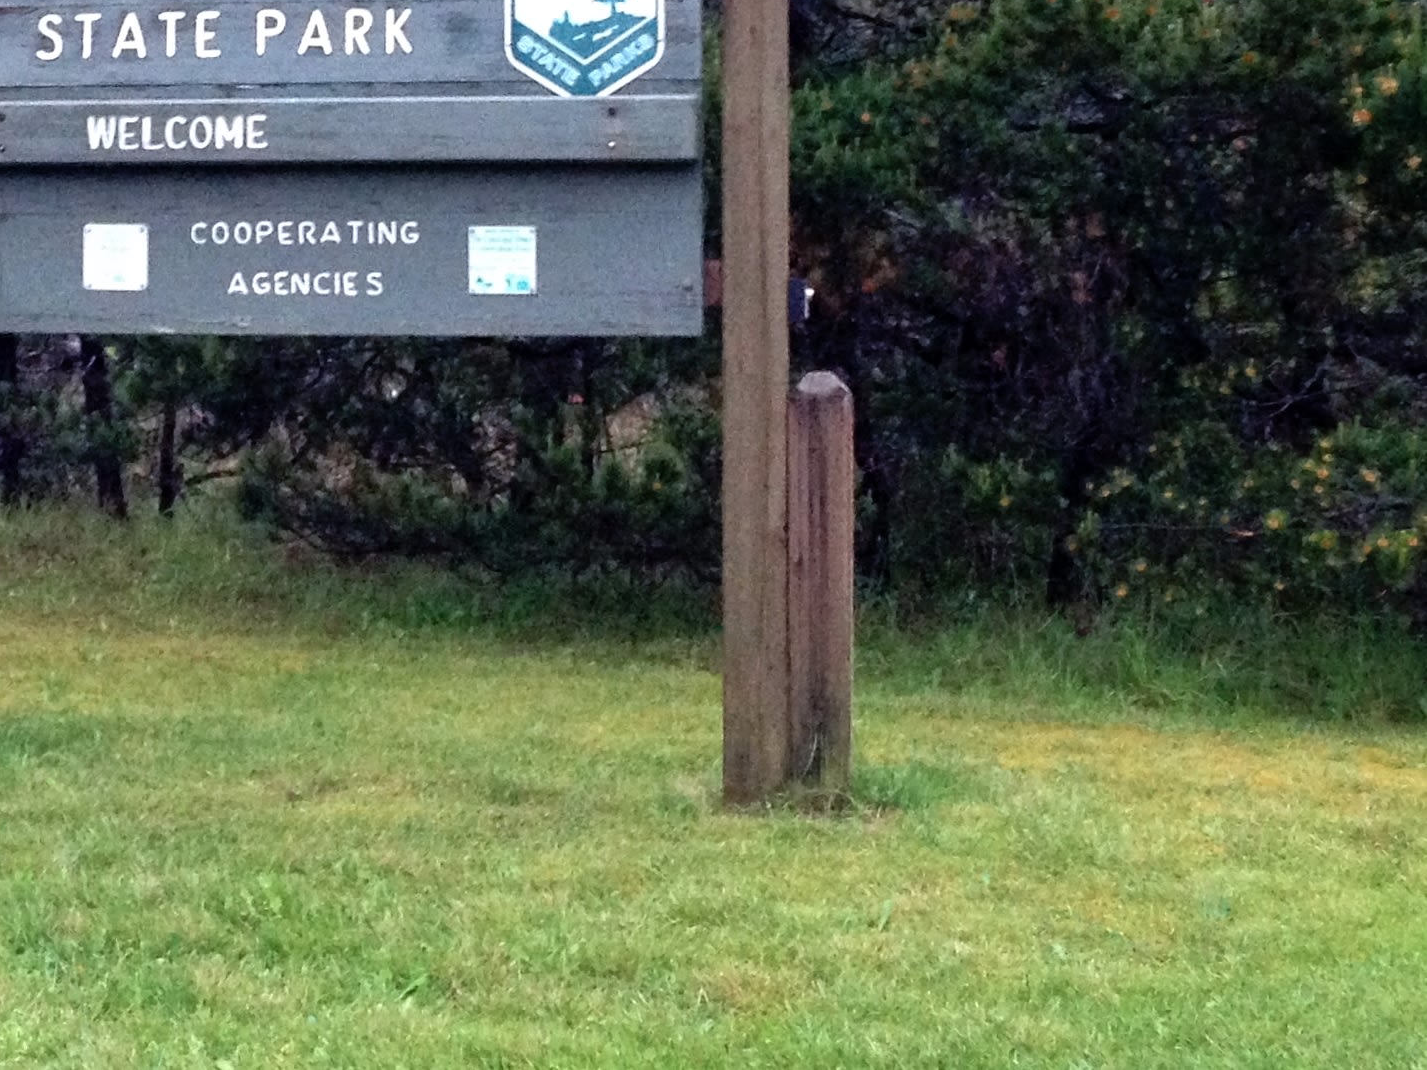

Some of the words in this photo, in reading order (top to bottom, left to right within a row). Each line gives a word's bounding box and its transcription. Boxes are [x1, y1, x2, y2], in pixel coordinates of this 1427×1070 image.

[36, 10, 221, 61] STATE
[255, 7, 414, 56] PARK
[516, 34, 582, 86] STATE
[87, 113, 268, 150] WELCOME
[190, 220, 421, 246] COOPERATING
[227, 270, 383, 297] AGENCIES
